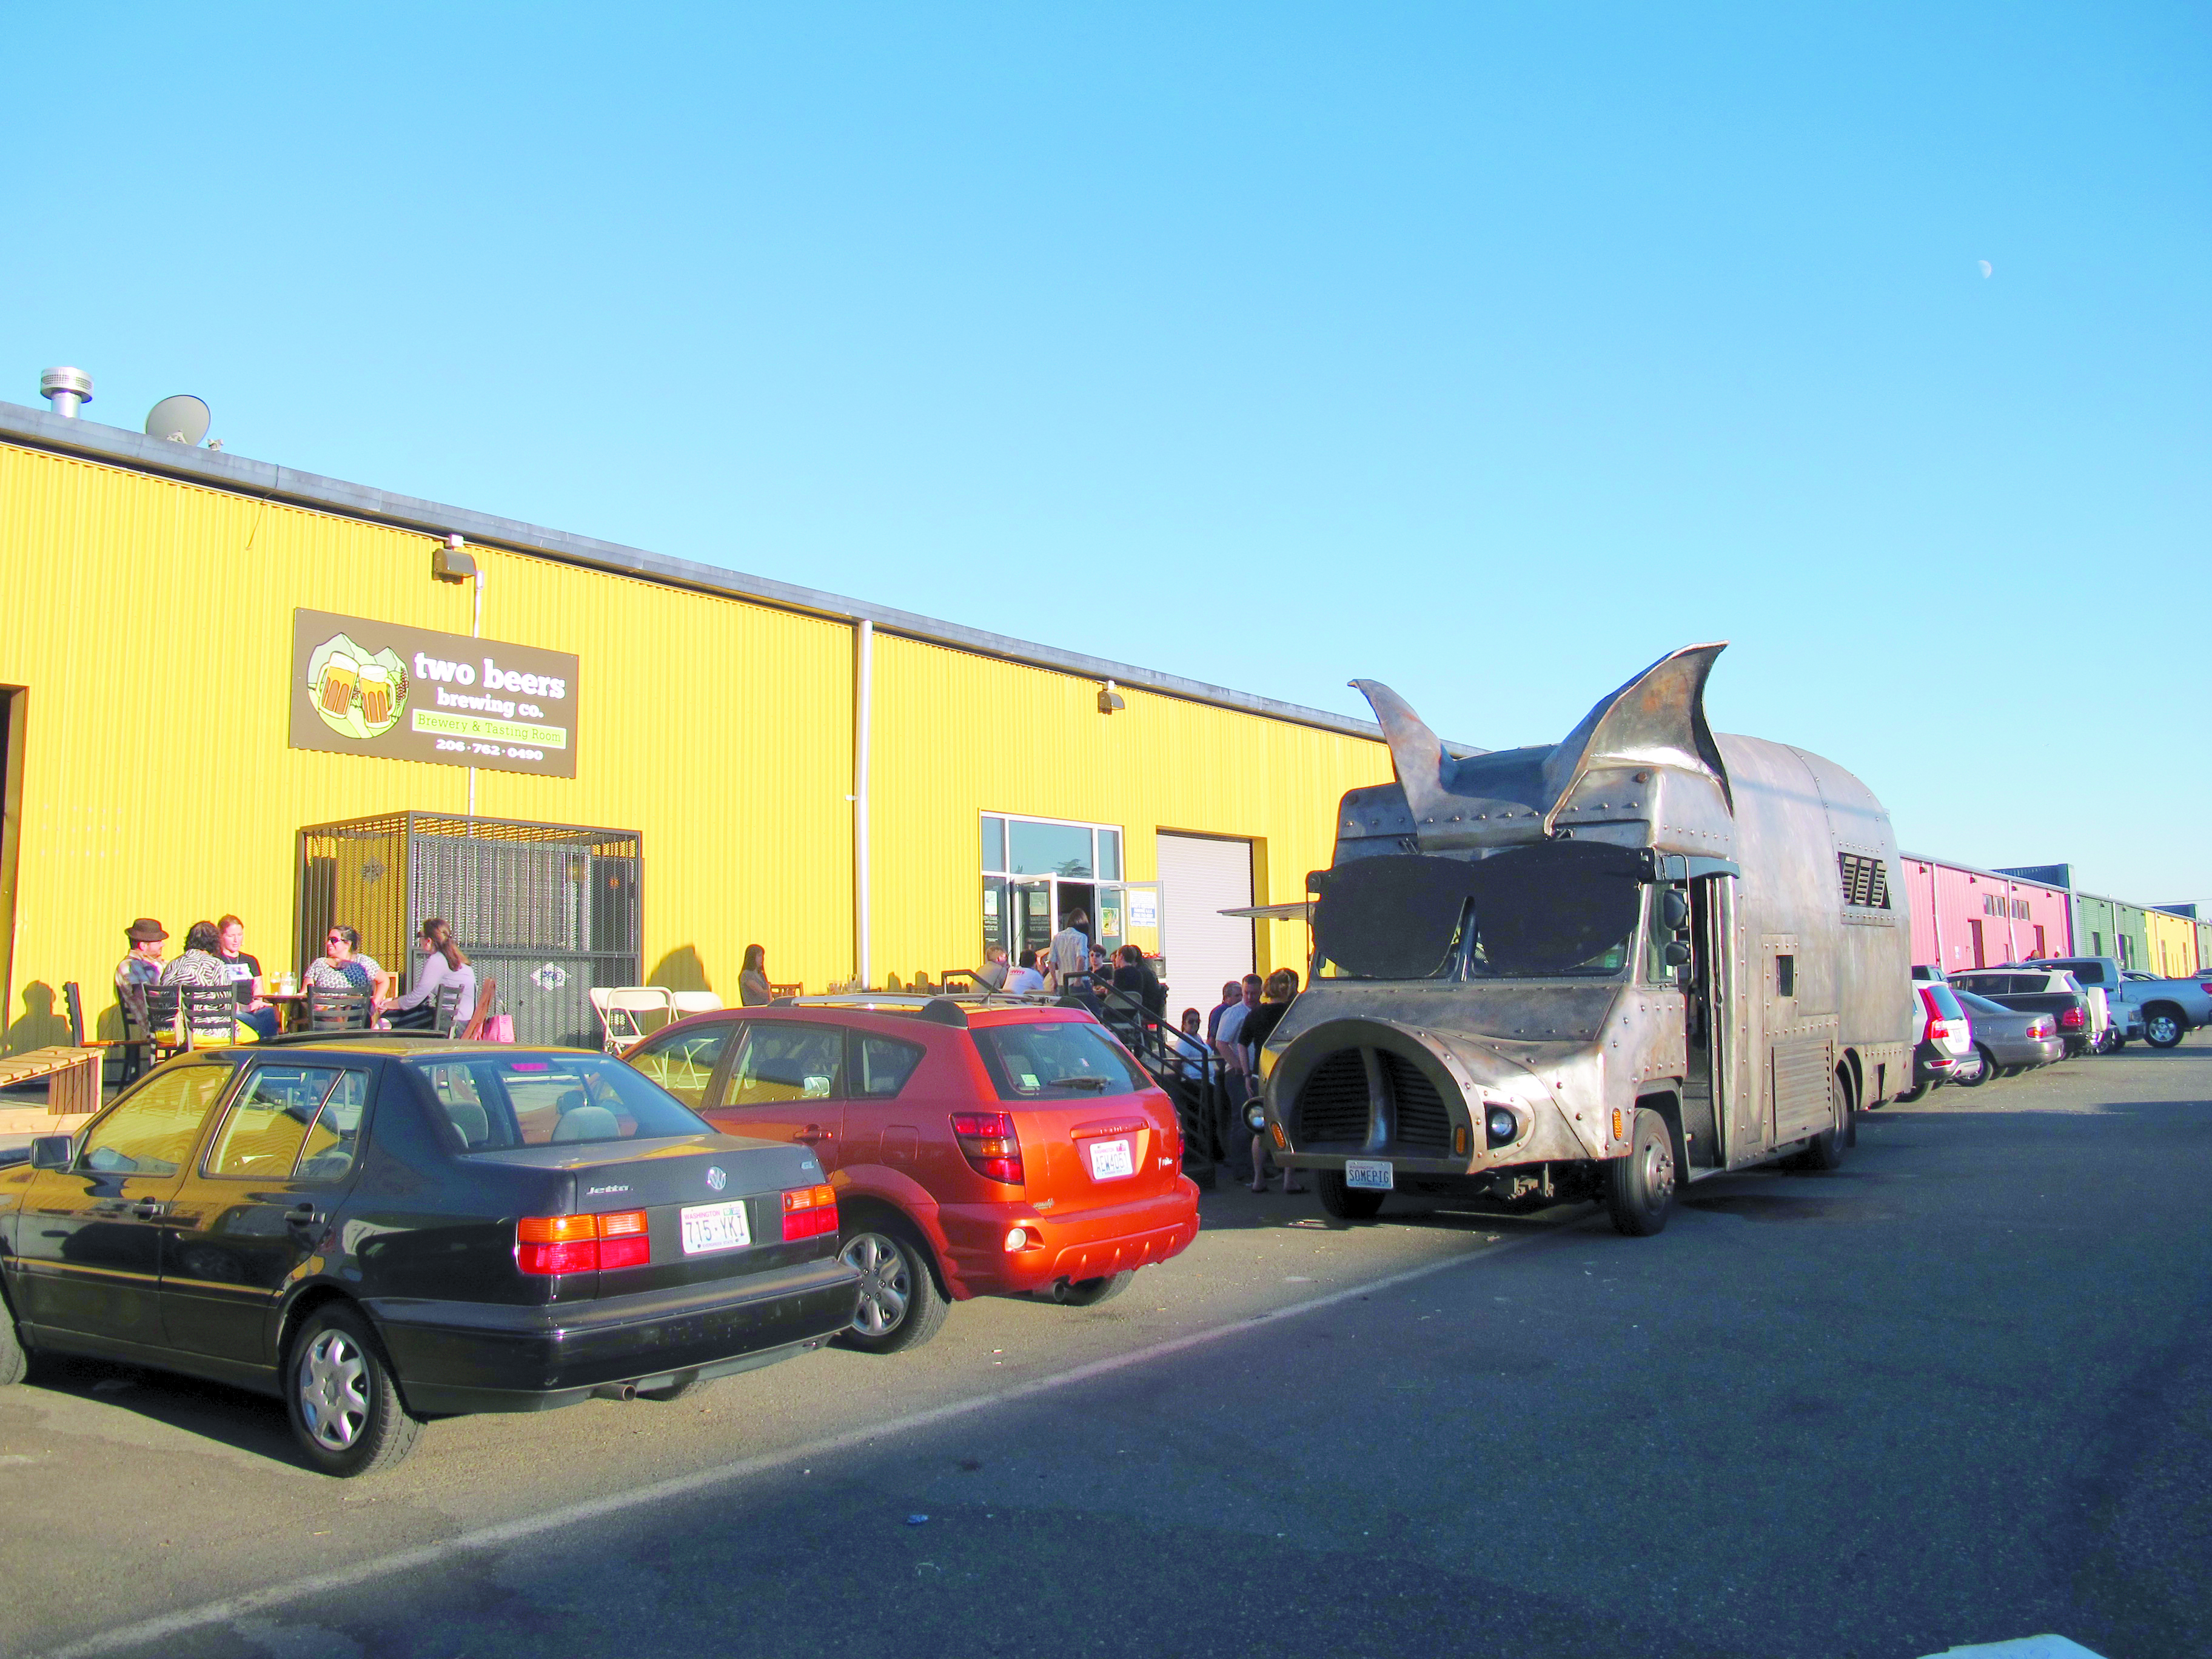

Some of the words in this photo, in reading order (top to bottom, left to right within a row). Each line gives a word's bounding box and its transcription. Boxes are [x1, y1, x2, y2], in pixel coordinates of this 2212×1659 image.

[414, 651, 476, 686] two
[483, 657, 566, 699] beers
[436, 687, 515, 719] brewing
[518, 703, 545, 719] co.
[418, 714, 468, 732] Brewery
[472, 720, 481, 732] &
[484, 722, 529, 740] Tasting
[532, 727, 561, 743] Room
[1096, 1152, 1128, 1173] AEW4051
[1349, 1170, 1389, 1183] SOMEPIG
[586, 1184, 629, 1195] Jetta
[683, 1210, 720, 1219] WASHINGTON
